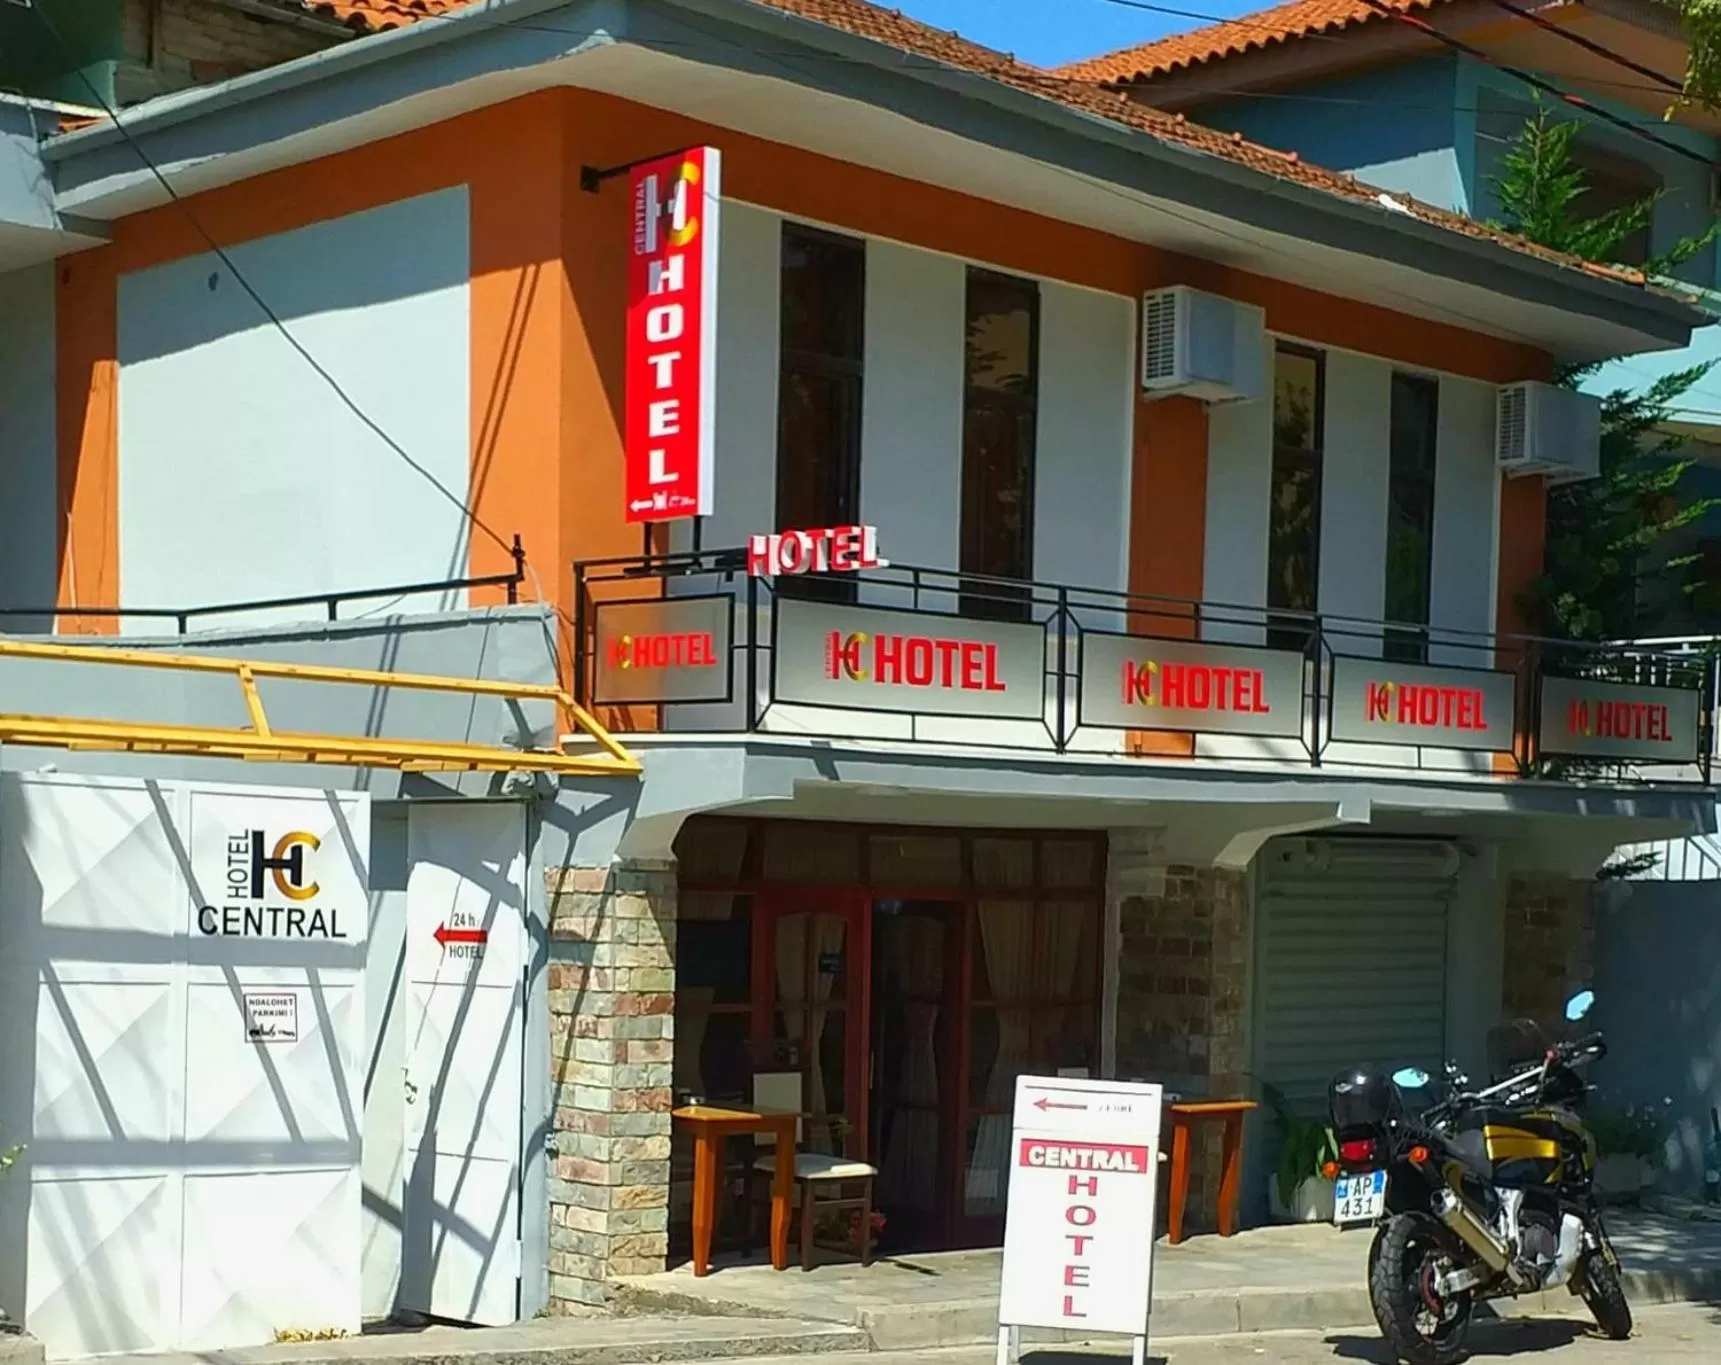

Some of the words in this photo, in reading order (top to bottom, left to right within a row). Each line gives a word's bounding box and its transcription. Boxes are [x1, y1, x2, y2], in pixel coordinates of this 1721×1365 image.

[635, 182, 645, 255] CENTRAL
[646, 253, 685, 484] HOTEL
[747, 525, 888, 576] HOTEL
[633, 634, 716, 668] HOTEL
[874, 634, 1006, 692] HOTEL
[1161, 664, 1270, 713] HOTEL
[1398, 684, 1488, 730] HOTEL
[1596, 701, 1673, 741] HOTEL
[227, 829, 249, 899] HOTEL
[198, 905, 347, 938] CENTRAL
[453, 912, 466, 927] 24
[468, 912, 476, 927] h
[449, 945, 484, 959] HOTEL
[1028, 1145, 1139, 1171] CENTRAL
[1340, 1197, 1373, 1217] 431
[1353, 1177, 1372, 1196] AP
[1063, 1174, 1098, 1317] HOTEL
